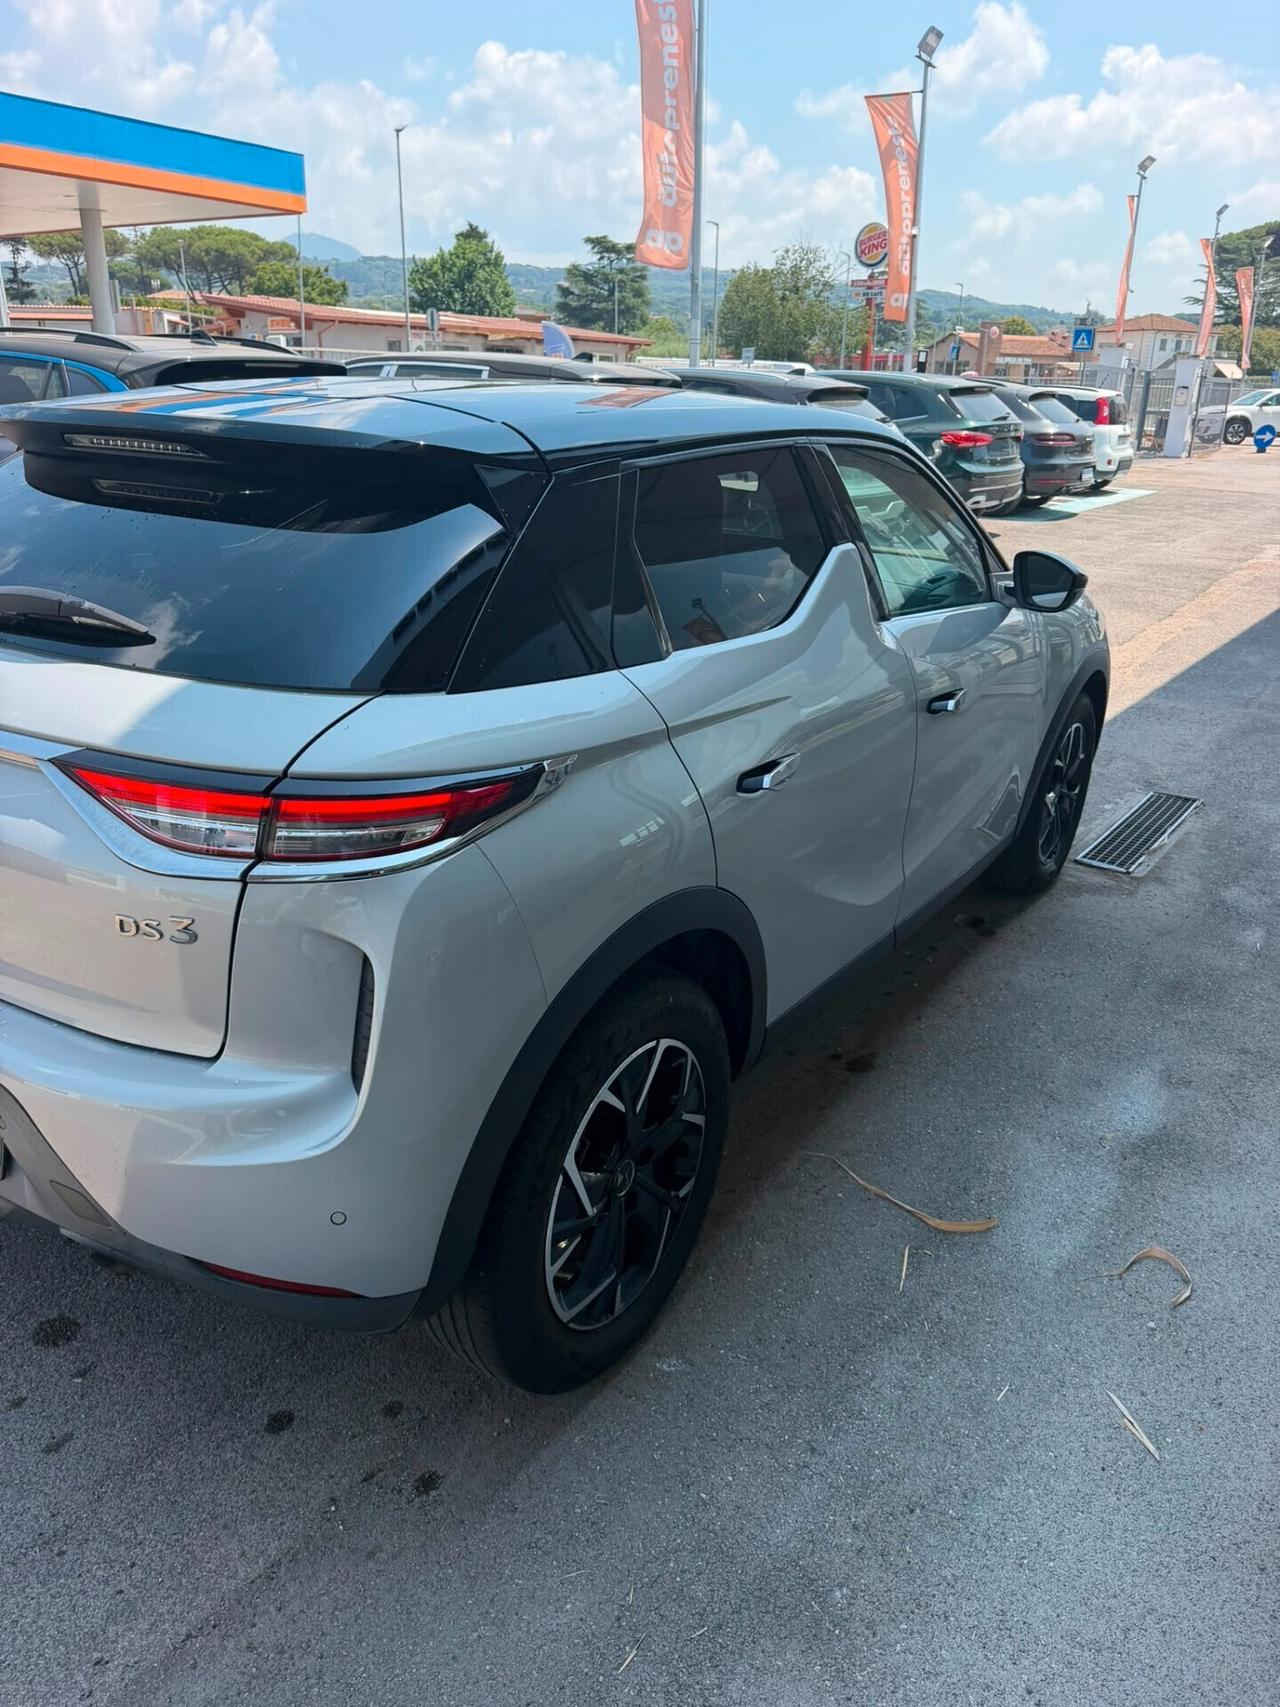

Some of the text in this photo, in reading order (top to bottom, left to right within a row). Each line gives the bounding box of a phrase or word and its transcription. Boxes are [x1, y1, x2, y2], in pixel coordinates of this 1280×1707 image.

[657, 0, 680, 208] autoprenes
[859, 230, 887, 248] BURGER
[859, 238, 888, 258] KING
